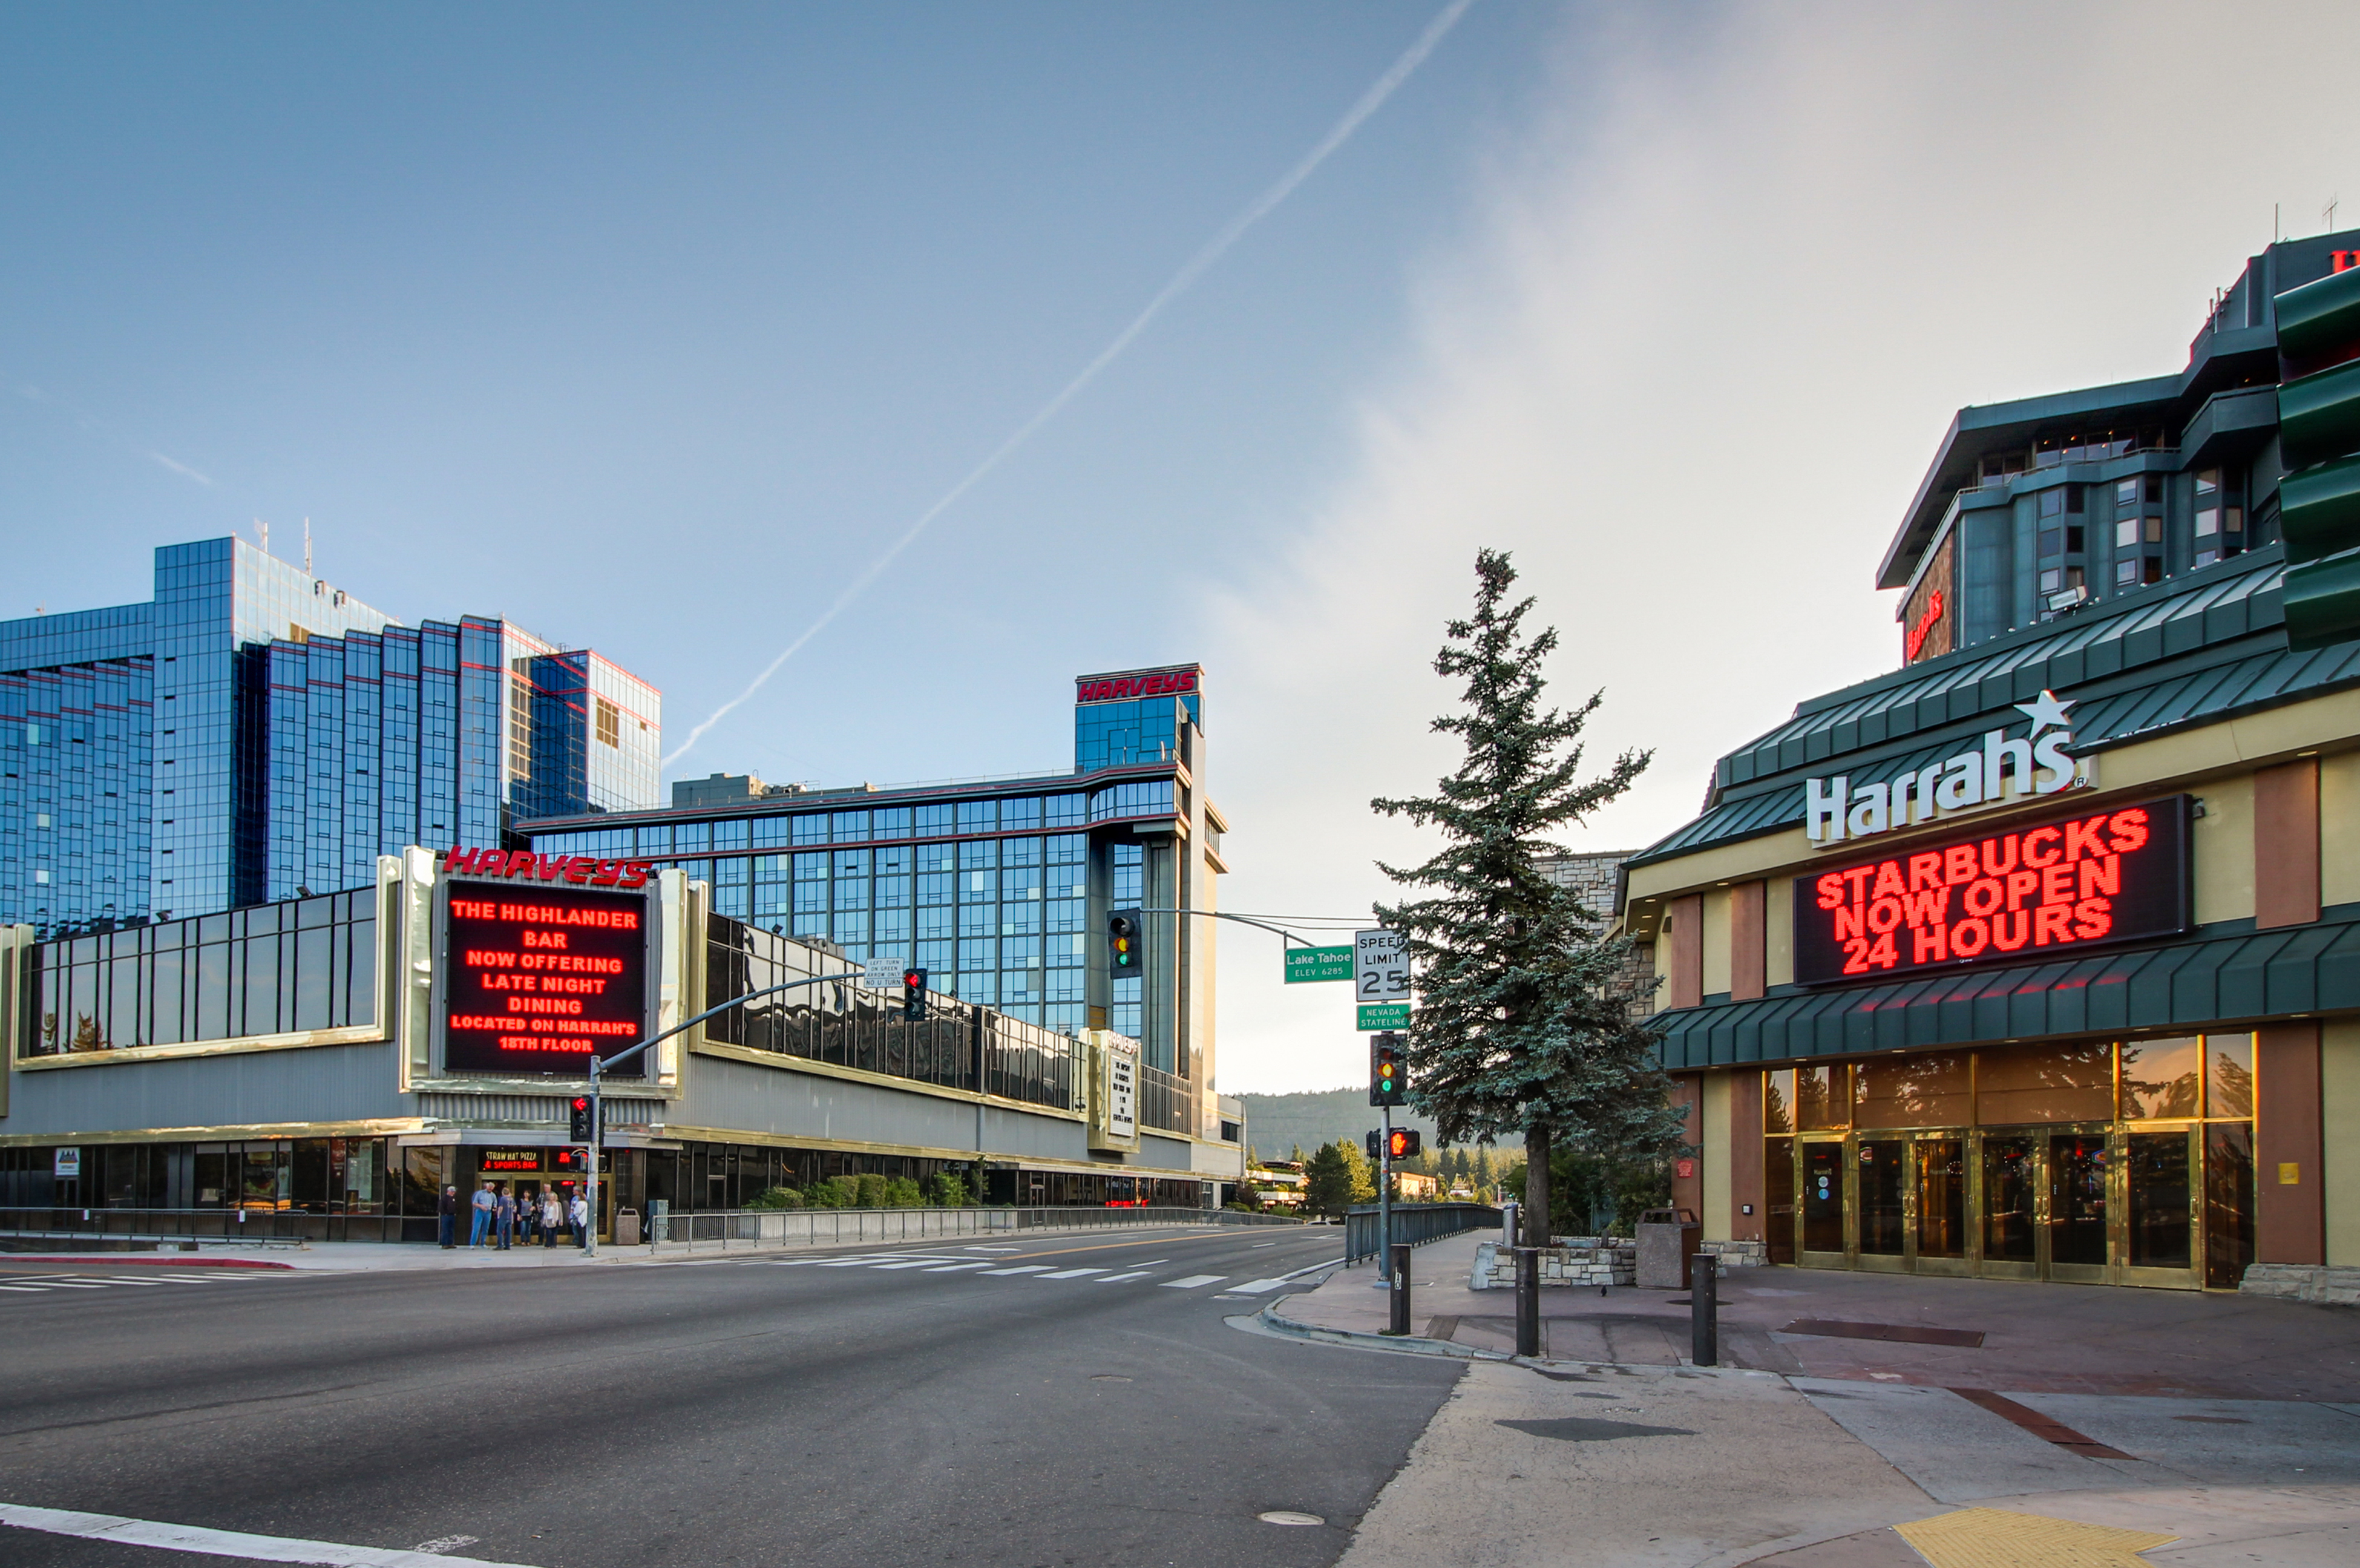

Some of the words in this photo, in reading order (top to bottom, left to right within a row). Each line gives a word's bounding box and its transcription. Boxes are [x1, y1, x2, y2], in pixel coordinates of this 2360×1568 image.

[1078, 671, 1198, 701] HARVEYS
[442, 845, 654, 888] HARVEYS
[1817, 807, 2149, 910] STARBUCKS
[1834, 886, 1950, 942] NOW
[1964, 854, 2121, 919] OPEN
[451, 900, 496, 920] THE
[500, 904, 638, 929] HIGHLANDER
[523, 931, 568, 949] BAR
[1360, 937, 1405, 948] SPEED
[1843, 932, 1899, 975] 24
[1913, 896, 2113, 965] HOURS
[466, 950, 515, 968] NOW
[520, 954, 623, 974] OFFERING
[1287, 954, 1314, 965] Lake
[1317, 953, 1351, 963] Tahoe
[1365, 954, 1400, 965] LIMIT
[1322, 967, 1343, 976] 6285
[482, 973, 536, 991] LATE
[542, 976, 606, 994] NIGHT
[1362, 970, 1405, 994] 25
[508, 996, 583, 1014] DINING
[451, 1015, 526, 1031] LOCATED
[531, 1019, 554, 1032] ON
[557, 1020, 637, 1036] HARRAH'S
[1361, 1018, 1406, 1026] STATELINE
[499, 1037, 538, 1051] 18TH
[542, 1038, 593, 1053] FLOOR
[486, 1151, 506, 1160] STRAW
[507, 1152, 519, 1160] HAT
[520, 1152, 537, 1161] PIZZA
[494, 1161, 522, 1169] SPORTS
[522, 1161, 538, 1169] BAR
